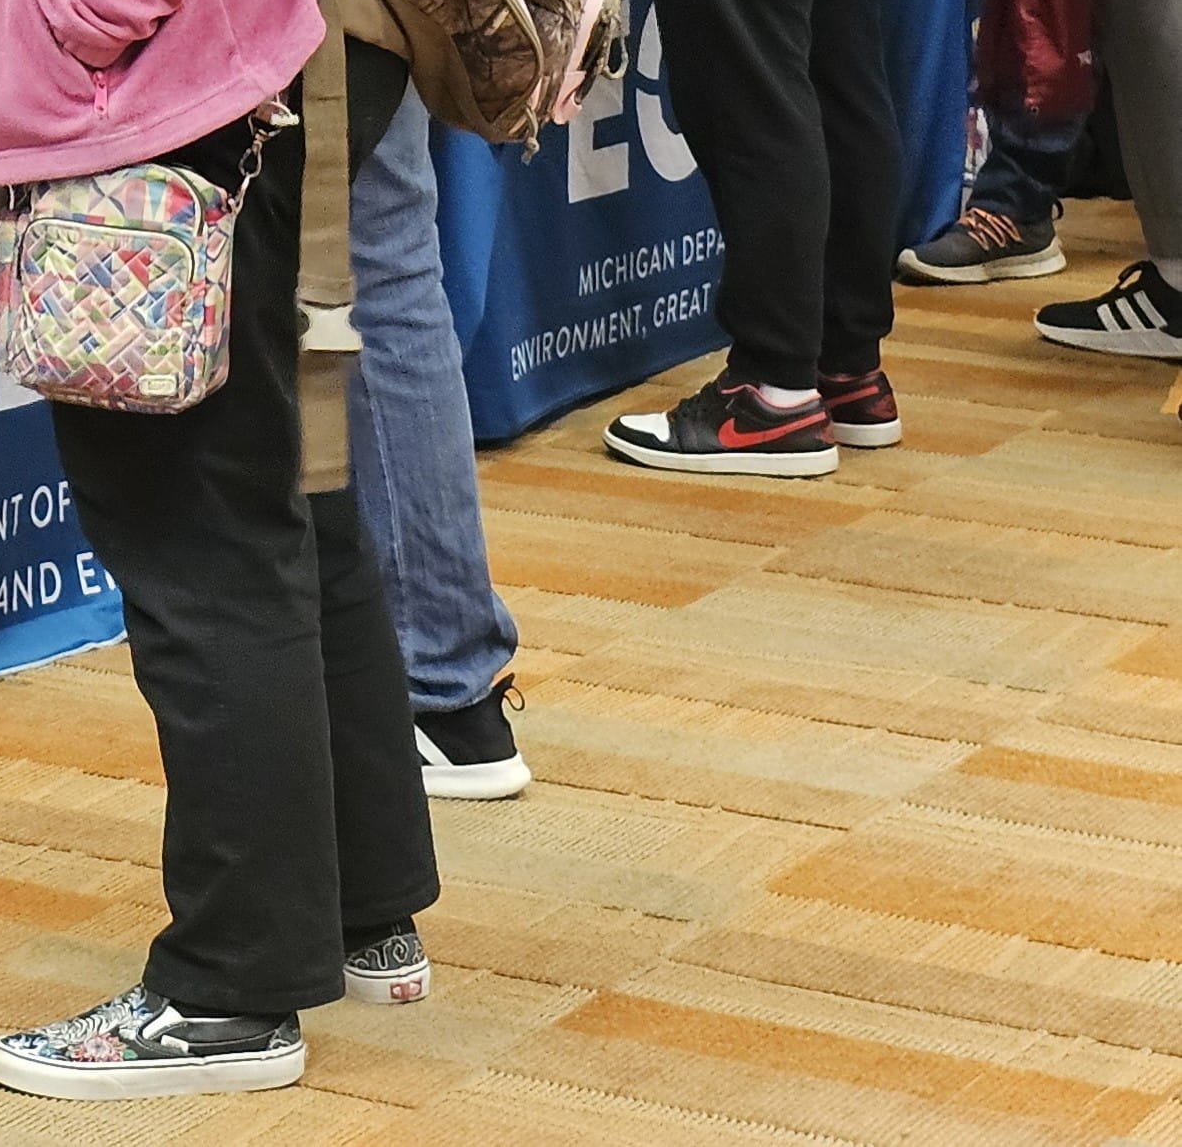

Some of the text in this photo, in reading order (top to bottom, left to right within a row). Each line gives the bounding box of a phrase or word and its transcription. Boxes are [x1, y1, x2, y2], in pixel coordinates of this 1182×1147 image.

[578, 240, 675, 297] MICHIGAN
[511, 283, 711, 381] ENVIRONMENT, GREAT
